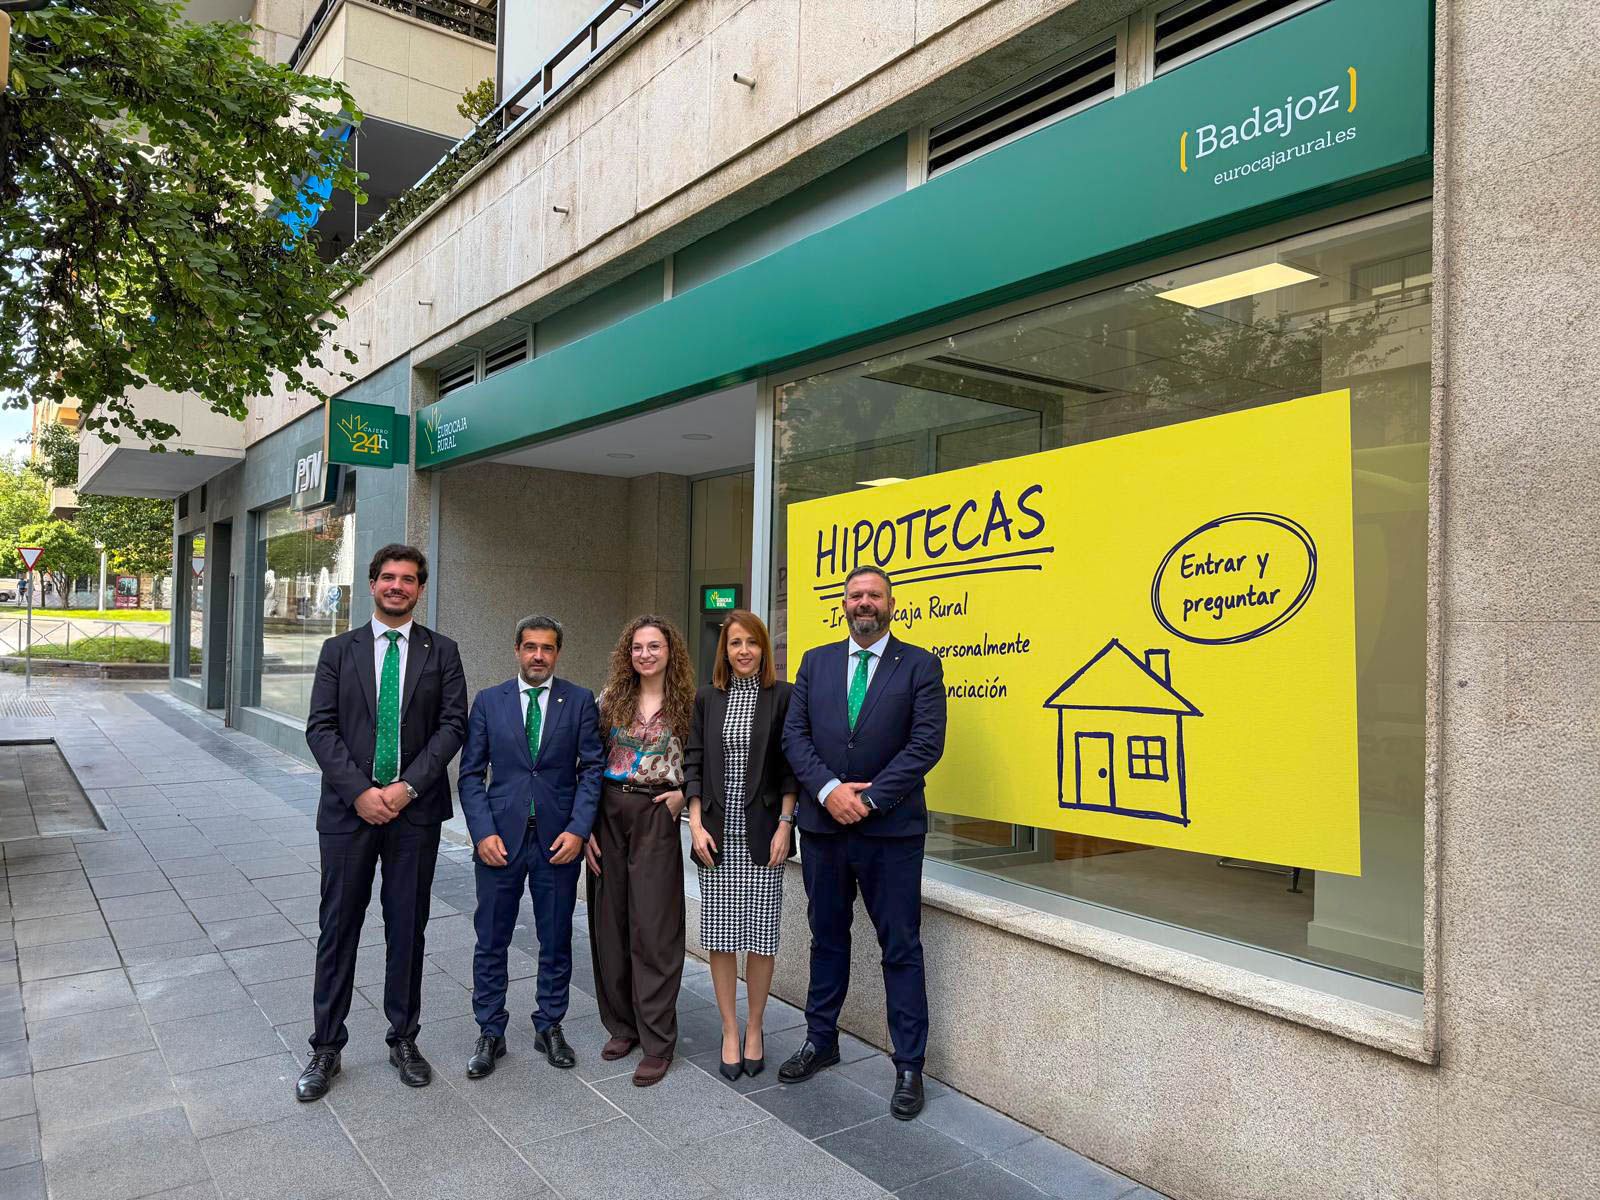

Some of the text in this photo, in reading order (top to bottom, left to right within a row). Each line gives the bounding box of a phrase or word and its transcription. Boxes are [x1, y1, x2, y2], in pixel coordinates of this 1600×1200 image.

[1213, 126, 1357, 185] eurocajarural.es
[363, 427, 389, 435] CAJERO
[437, 416, 468, 439] EUROCAJA
[351, 431, 389, 454] 24h
[437, 435, 457, 453] RURAL
[295, 450, 323, 494] PSN
[815, 484, 1046, 578] HIPOTECAS
[1180, 552, 1270, 579] Entrar y
[889, 601, 923, 630] caja
[928, 592, 969, 619] Rural
[1182, 584, 1281, 622] preguntar
[931, 632, 1031, 659] personalmente
[944, 676, 1008, 698] nciación
